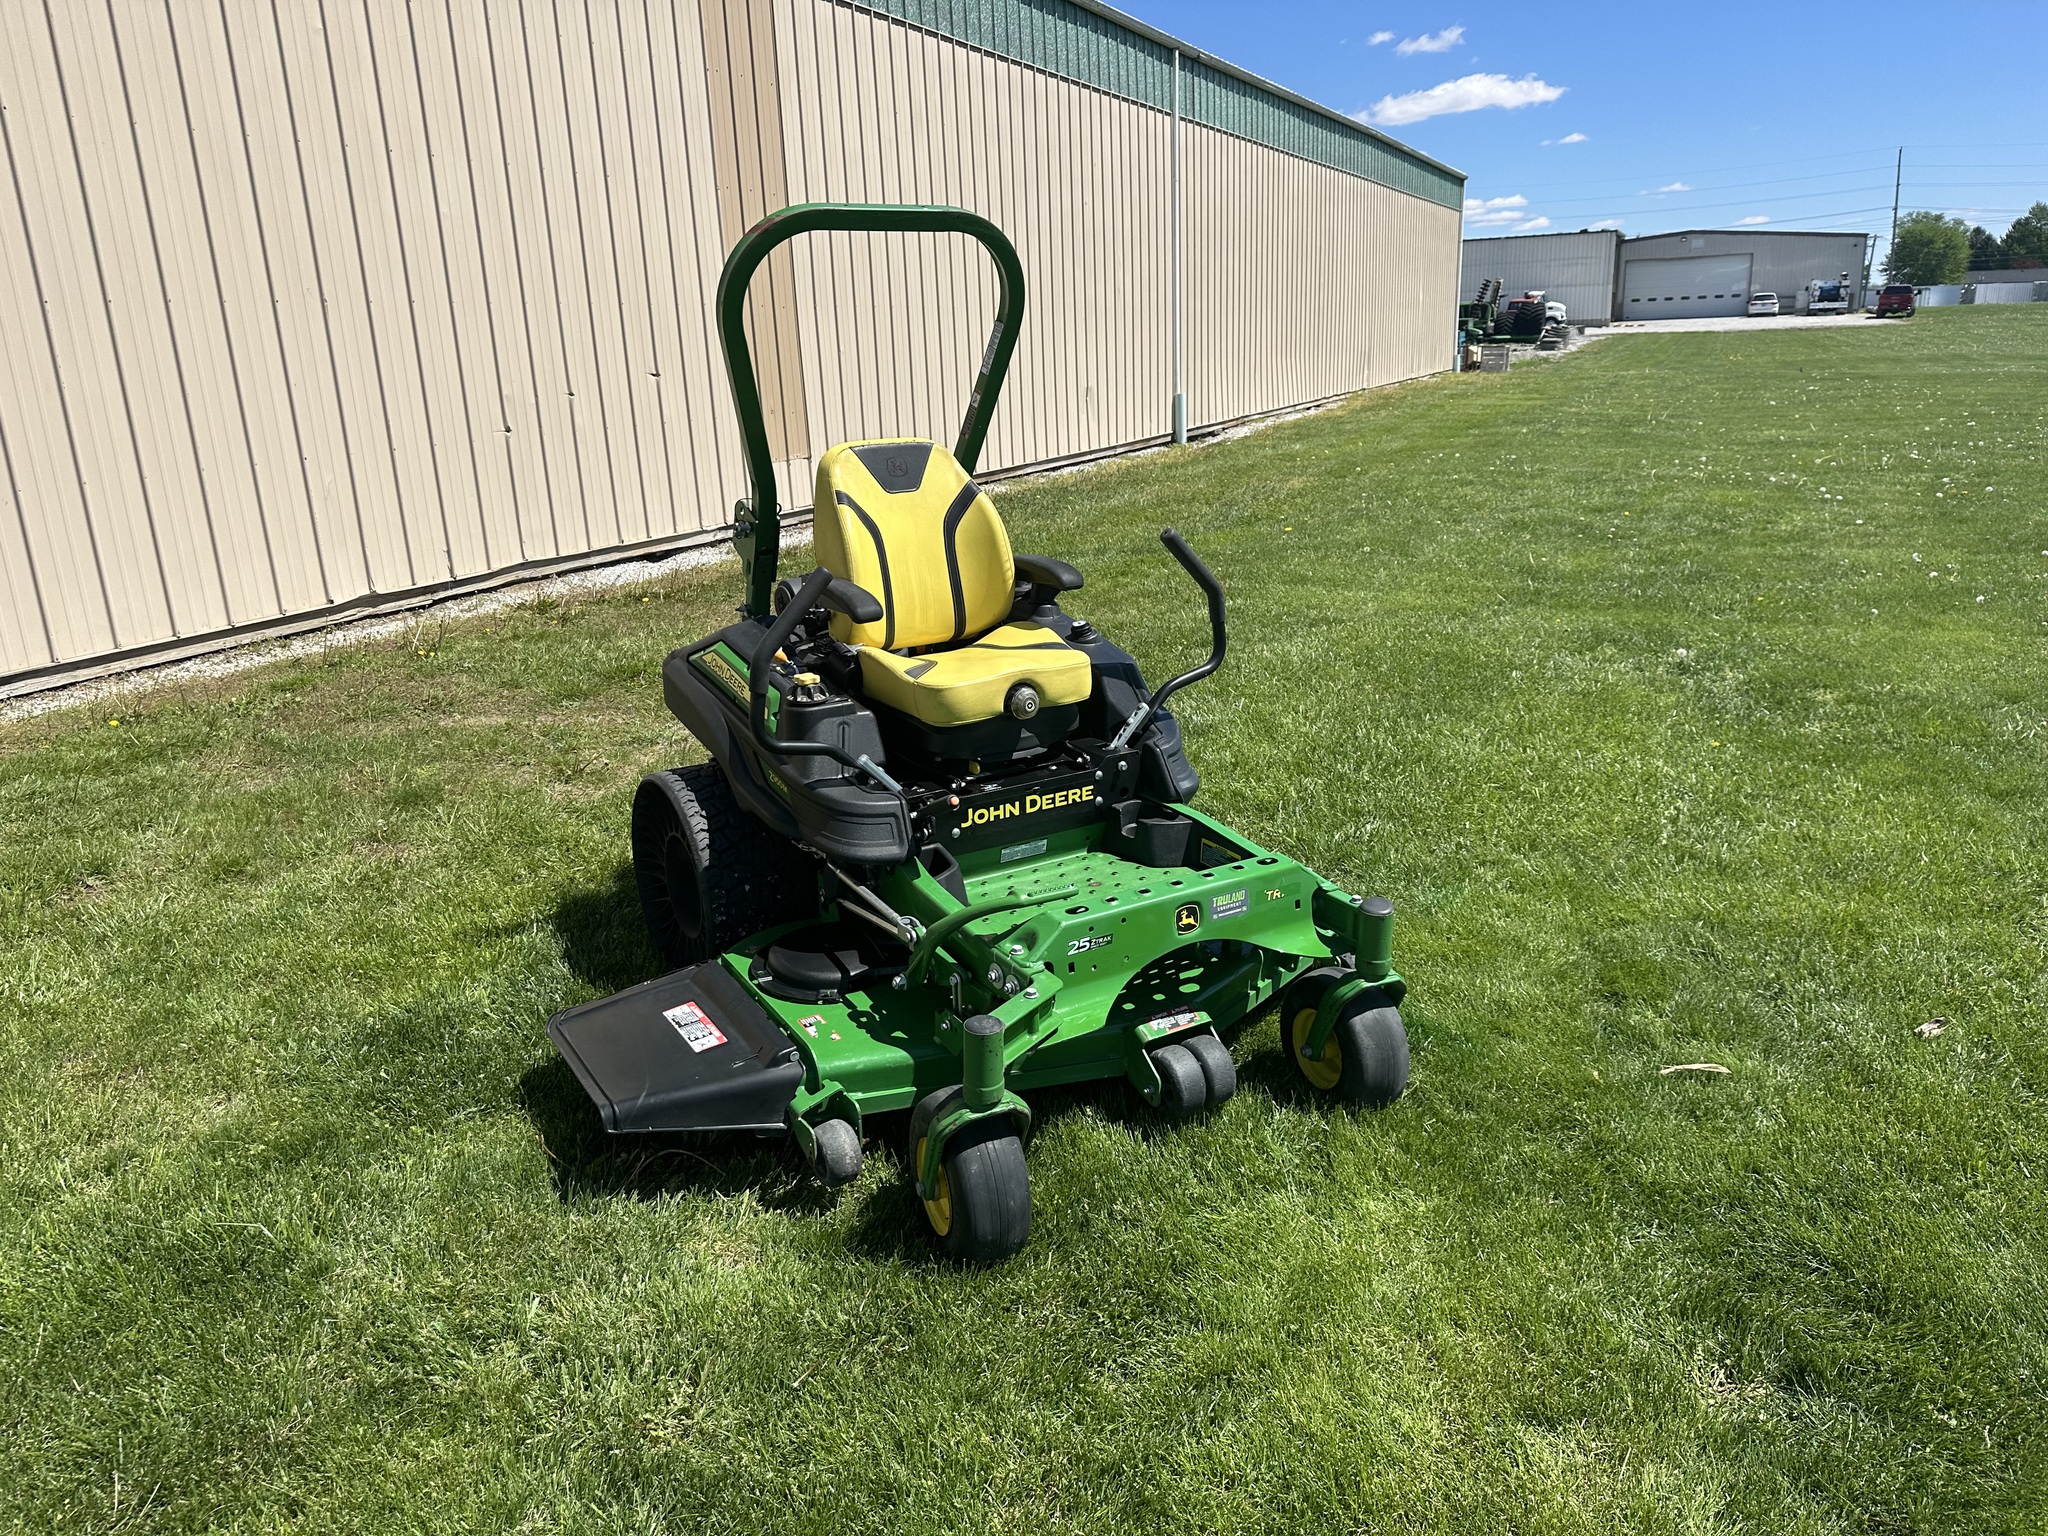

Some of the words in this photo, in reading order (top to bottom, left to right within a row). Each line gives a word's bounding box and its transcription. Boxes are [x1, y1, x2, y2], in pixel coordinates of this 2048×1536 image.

[706, 654, 726, 677] JOHN
[724, 668, 746, 696] DEERE
[961, 801, 1020, 828] JOHN
[1025, 785, 1094, 814] DEERE
[1212, 890, 1246, 907] TRULAND
[1067, 936, 1090, 956] 25
